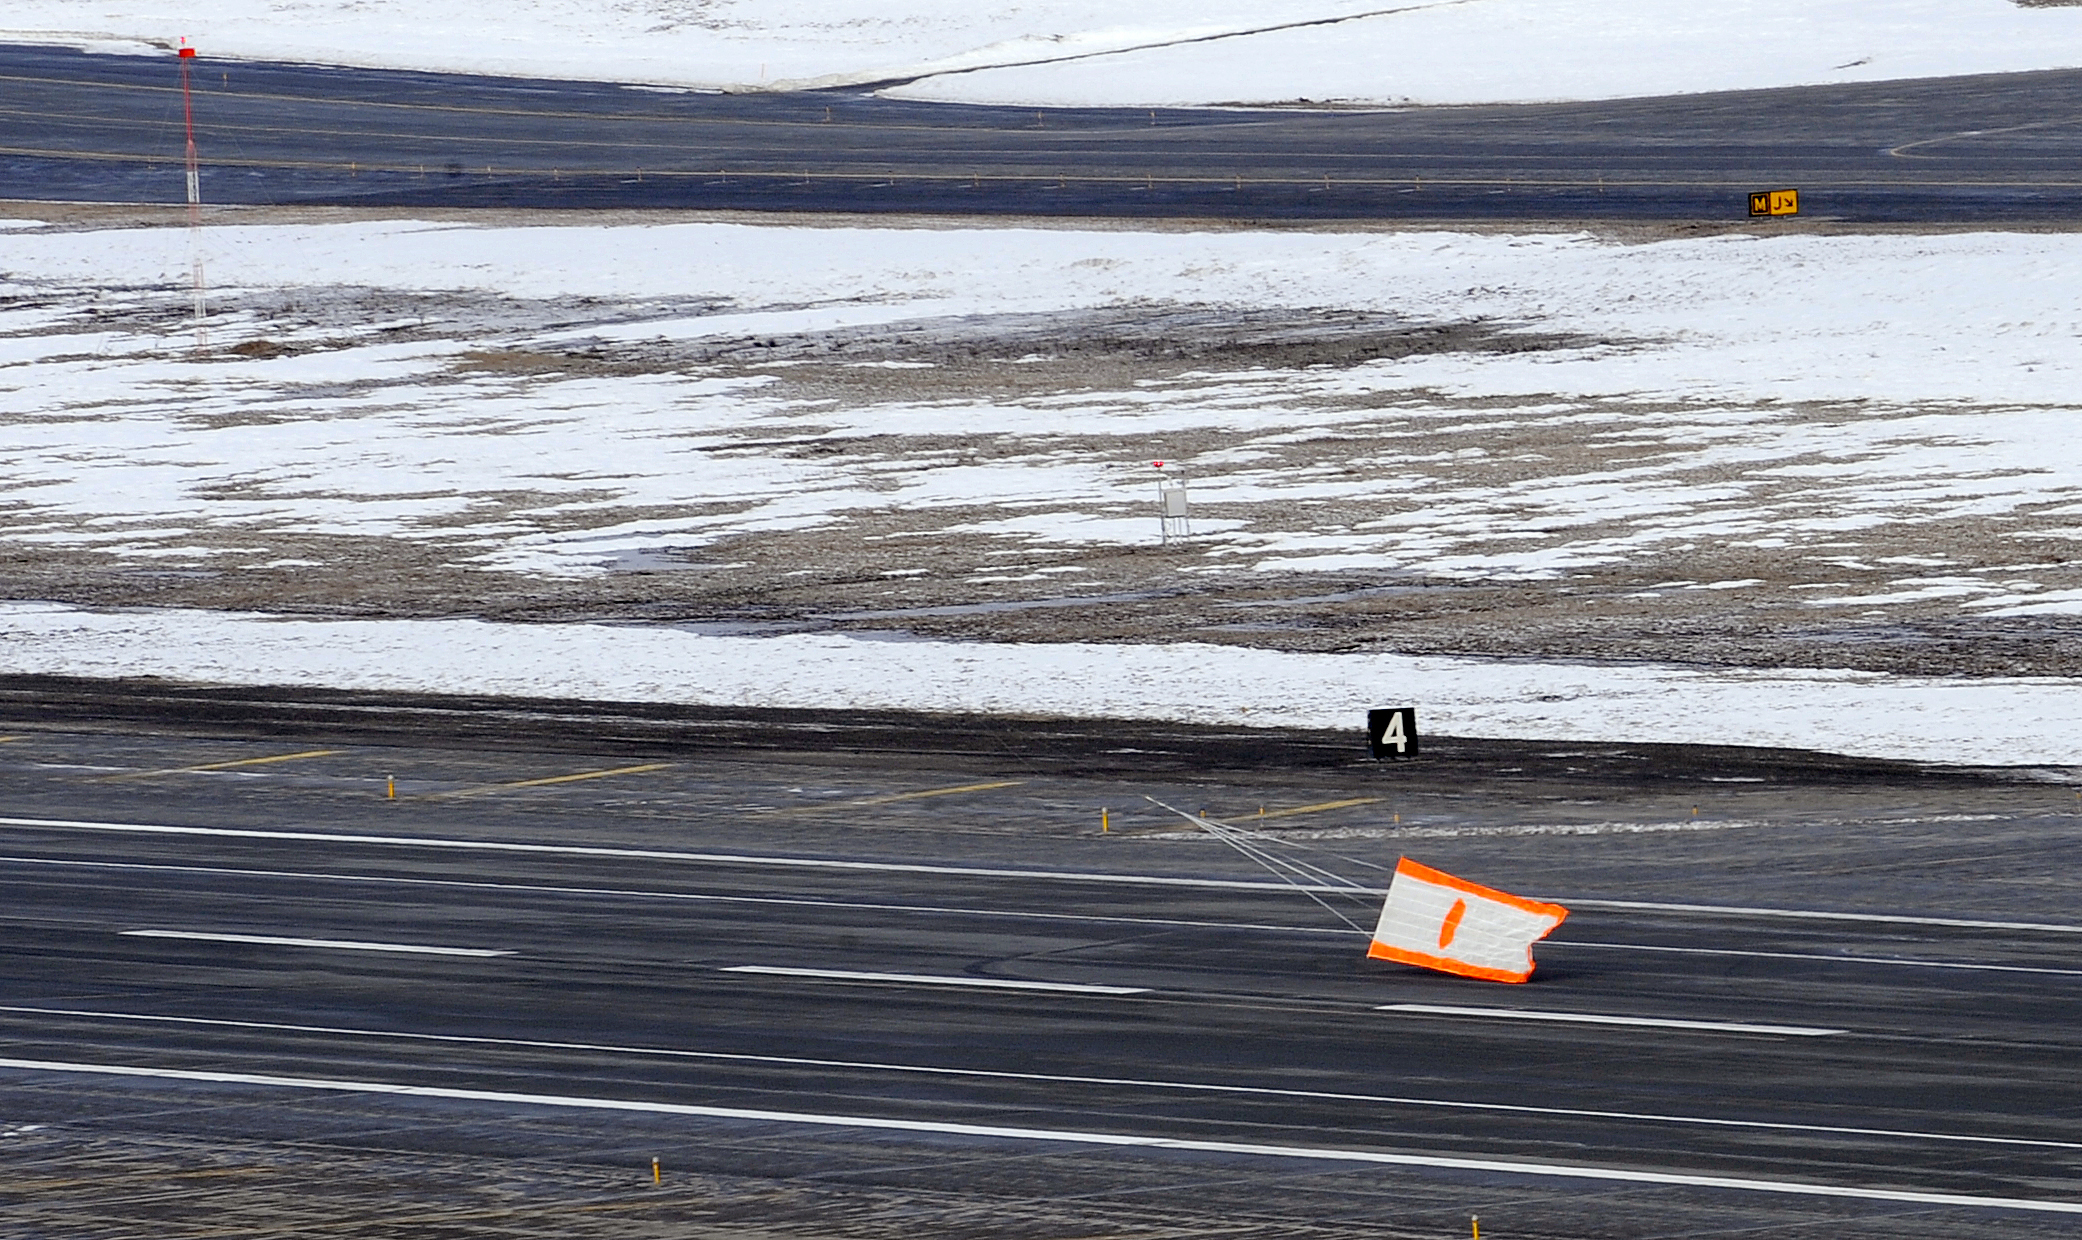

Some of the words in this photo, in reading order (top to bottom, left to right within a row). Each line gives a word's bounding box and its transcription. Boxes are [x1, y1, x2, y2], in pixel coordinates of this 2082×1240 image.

[1754, 196, 1766, 211] M
[1773, 196, 1782, 211] J
[1381, 711, 1408, 753] 4
